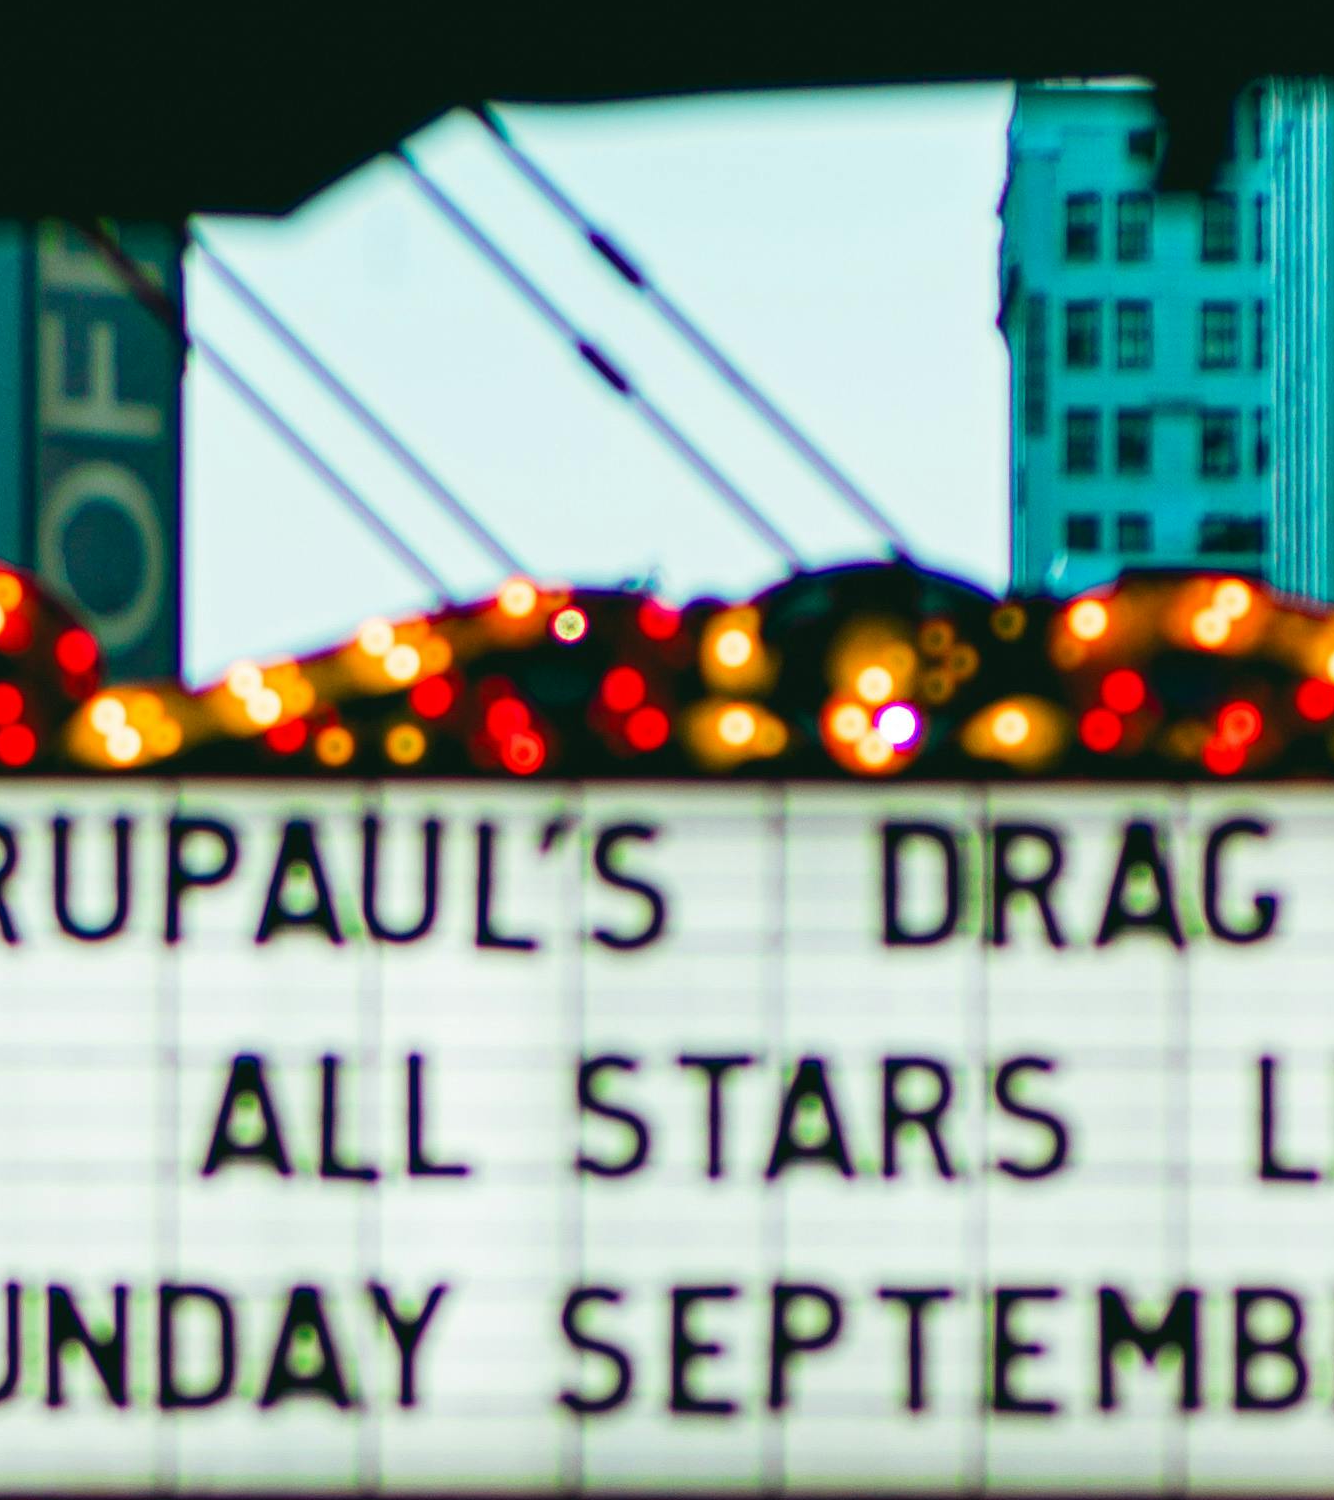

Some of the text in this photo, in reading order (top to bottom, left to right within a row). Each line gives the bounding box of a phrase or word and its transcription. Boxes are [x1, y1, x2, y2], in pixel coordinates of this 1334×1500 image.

[877, 814, 1279, 948] DRAG
[200, 1053, 471, 1183] ALL
[574, 1053, 1070, 1180] STARS
